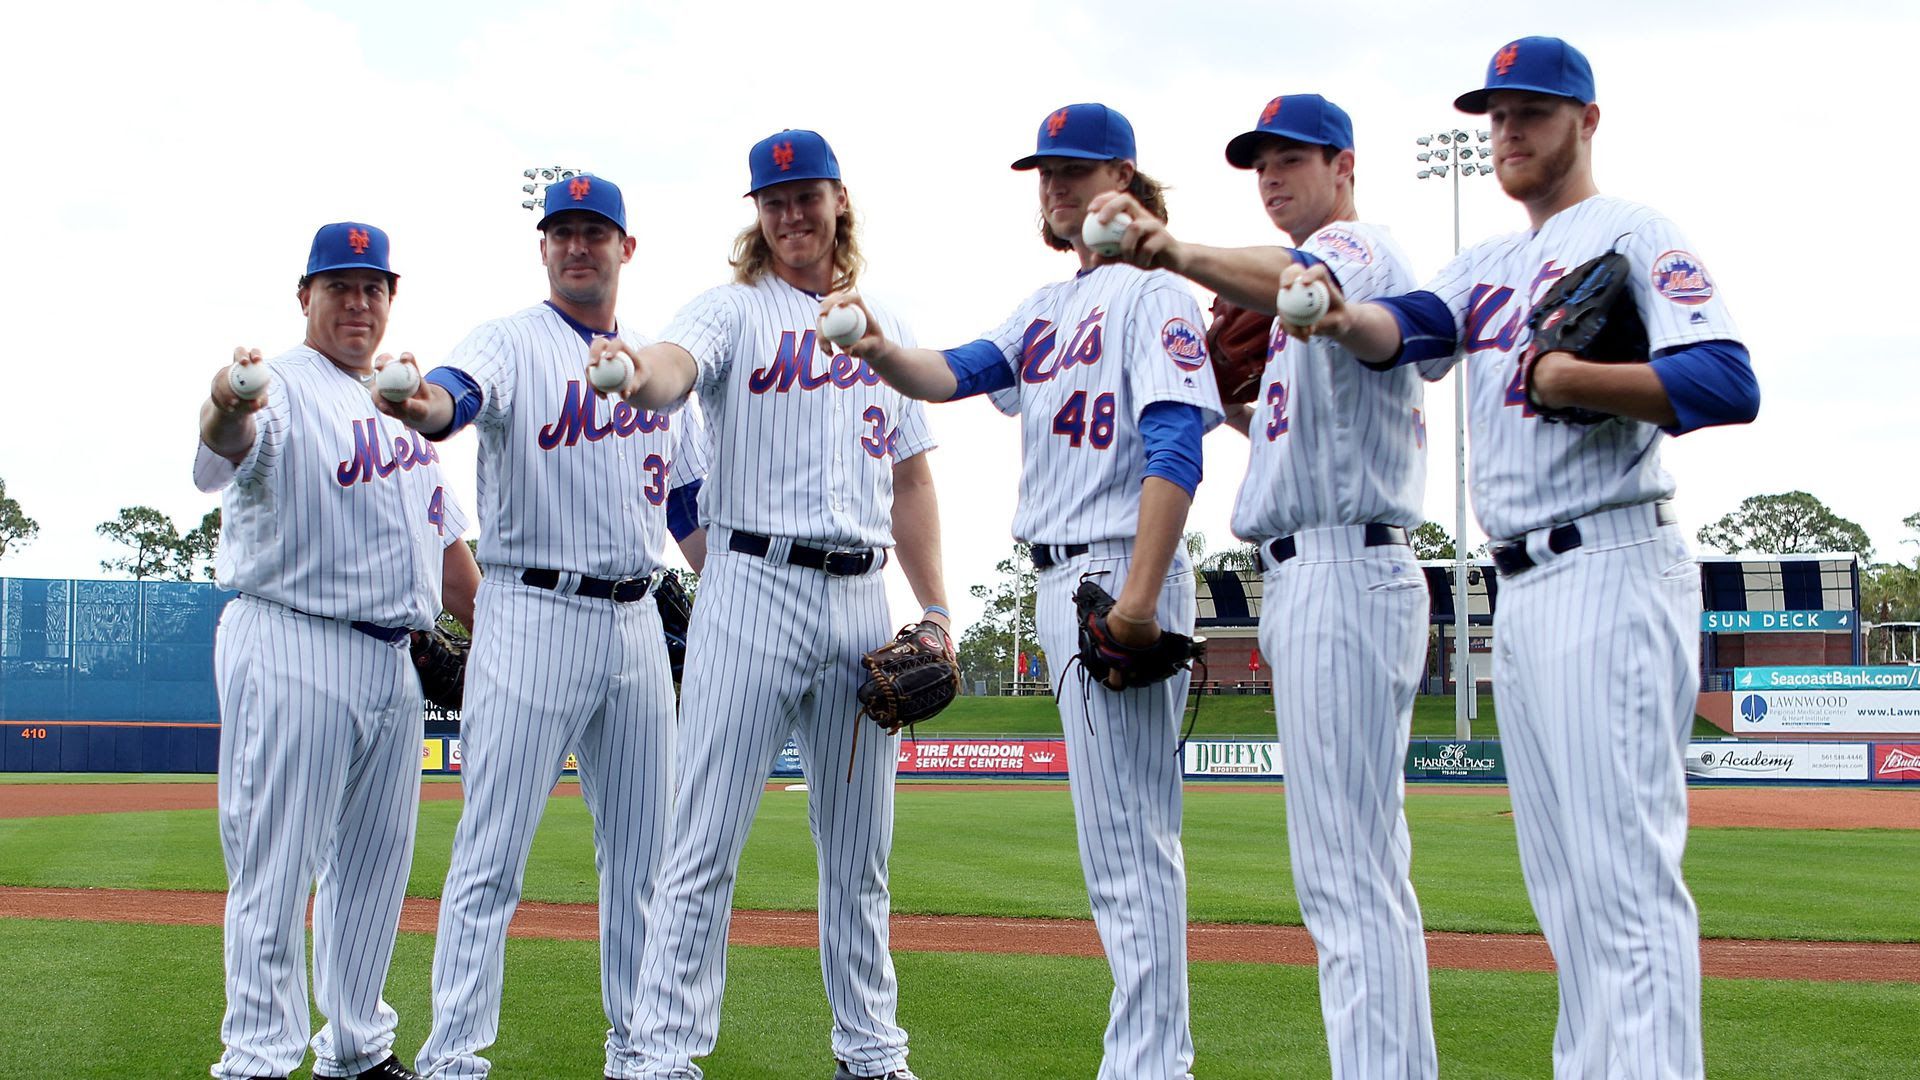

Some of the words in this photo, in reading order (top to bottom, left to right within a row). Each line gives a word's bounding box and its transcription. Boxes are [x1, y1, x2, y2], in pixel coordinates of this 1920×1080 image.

[1022, 304, 1105, 384] Mts
[1053, 390, 1115, 450] 48
[643, 453, 671, 506] 3
[1708, 615, 1750, 628] SUN
[1763, 613, 1819, 627] DECK
[1769, 696, 1848, 708] LAWNWOOD
[423, 710, 445, 721] IAL
[21, 728, 47, 739] 410
[916, 745, 949, 757] TIRE
[952, 745, 1024, 758] KINGDOM
[916, 758, 965, 768] SERVICE
[969, 758, 1023, 768] CENTERS
[1414, 757, 1462, 768] HARBOR
[1463, 758, 1495, 769] PLACE
[1719, 751, 1794, 771] Academy
